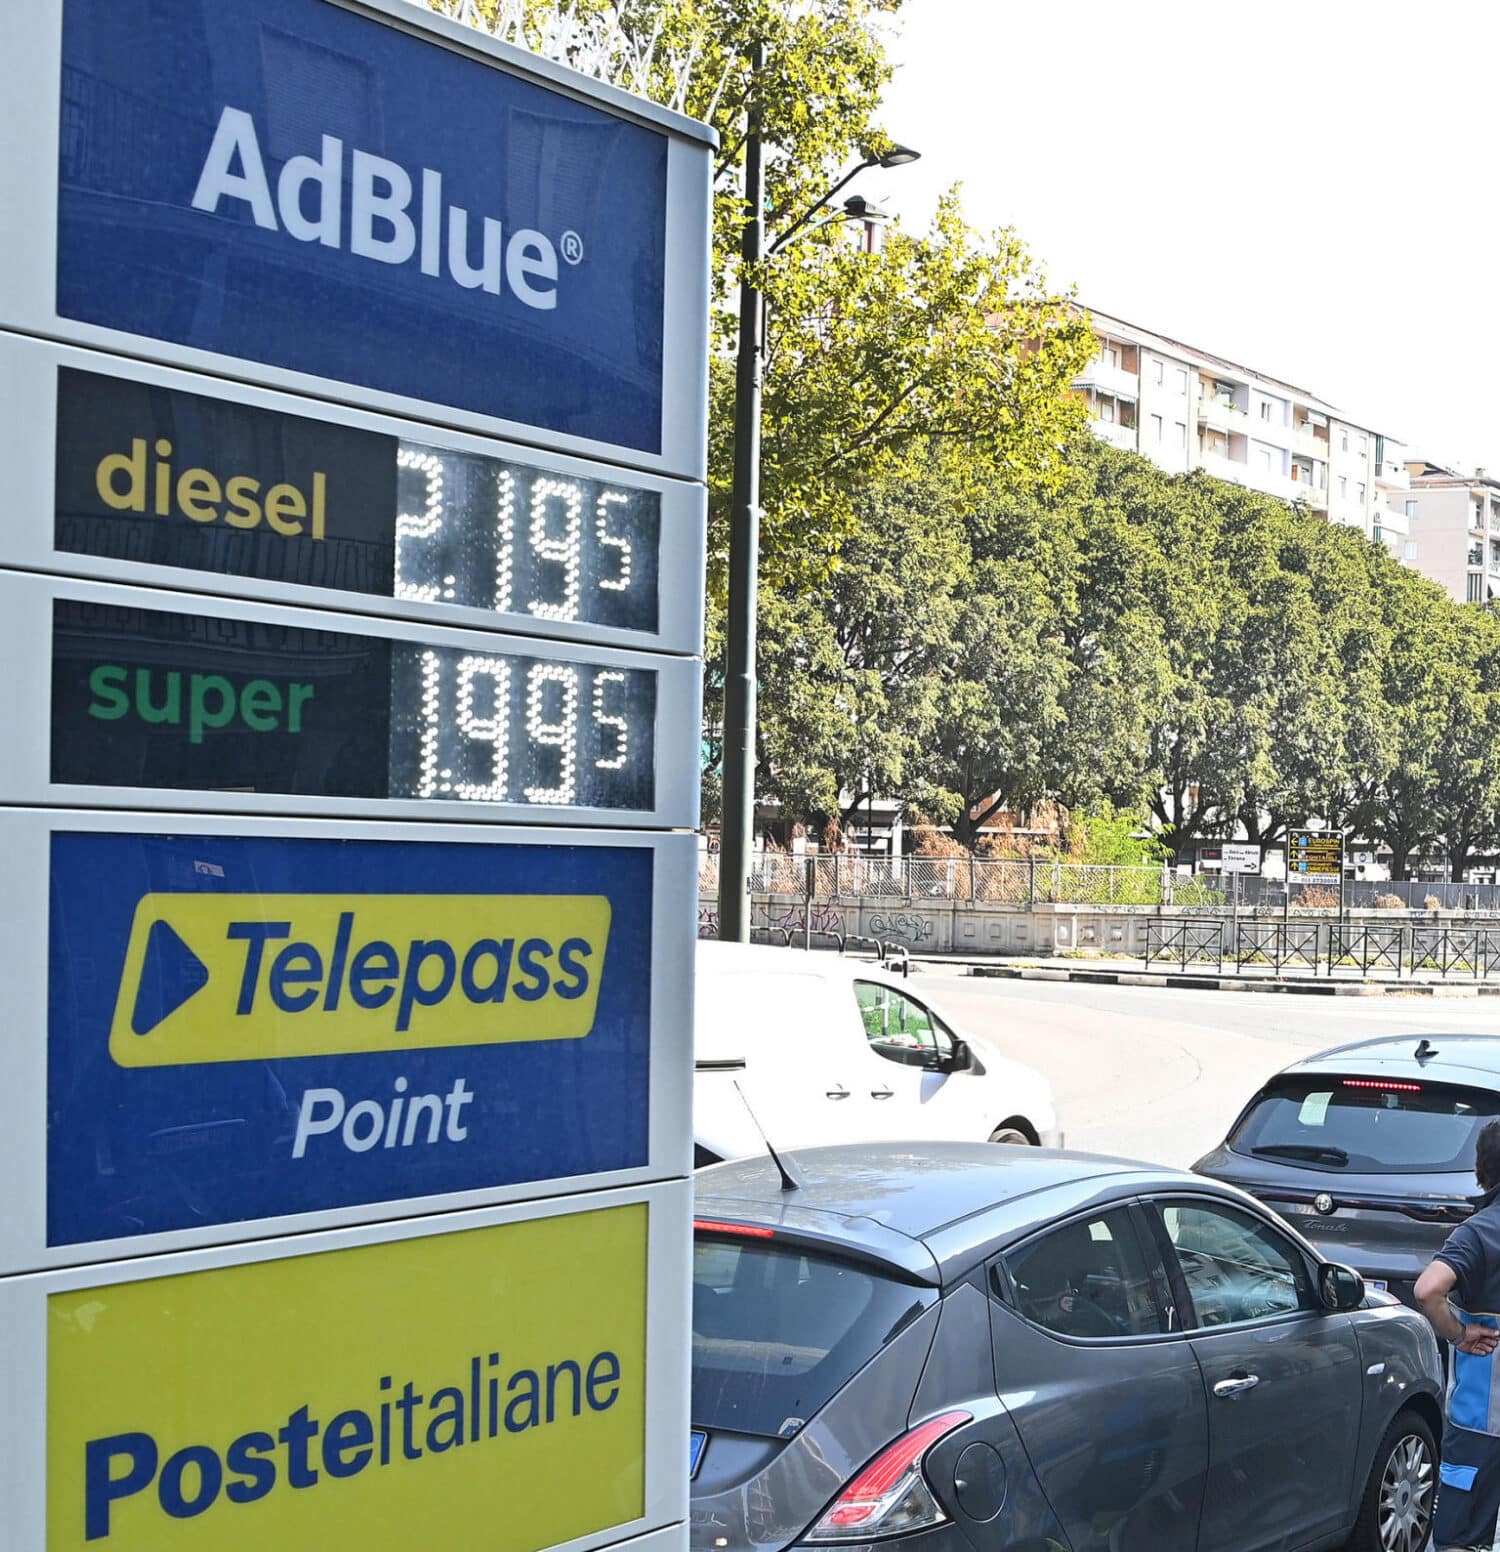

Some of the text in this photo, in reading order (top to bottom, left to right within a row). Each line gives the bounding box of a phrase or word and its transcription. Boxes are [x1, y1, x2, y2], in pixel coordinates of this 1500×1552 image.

[96, 439, 325, 540] diesel
[87, 664, 314, 744] super
[227, 911, 593, 1032] Telepass
[292, 1076, 474, 1159] Point
[85, 1350, 621, 1542] Posteitaliane
